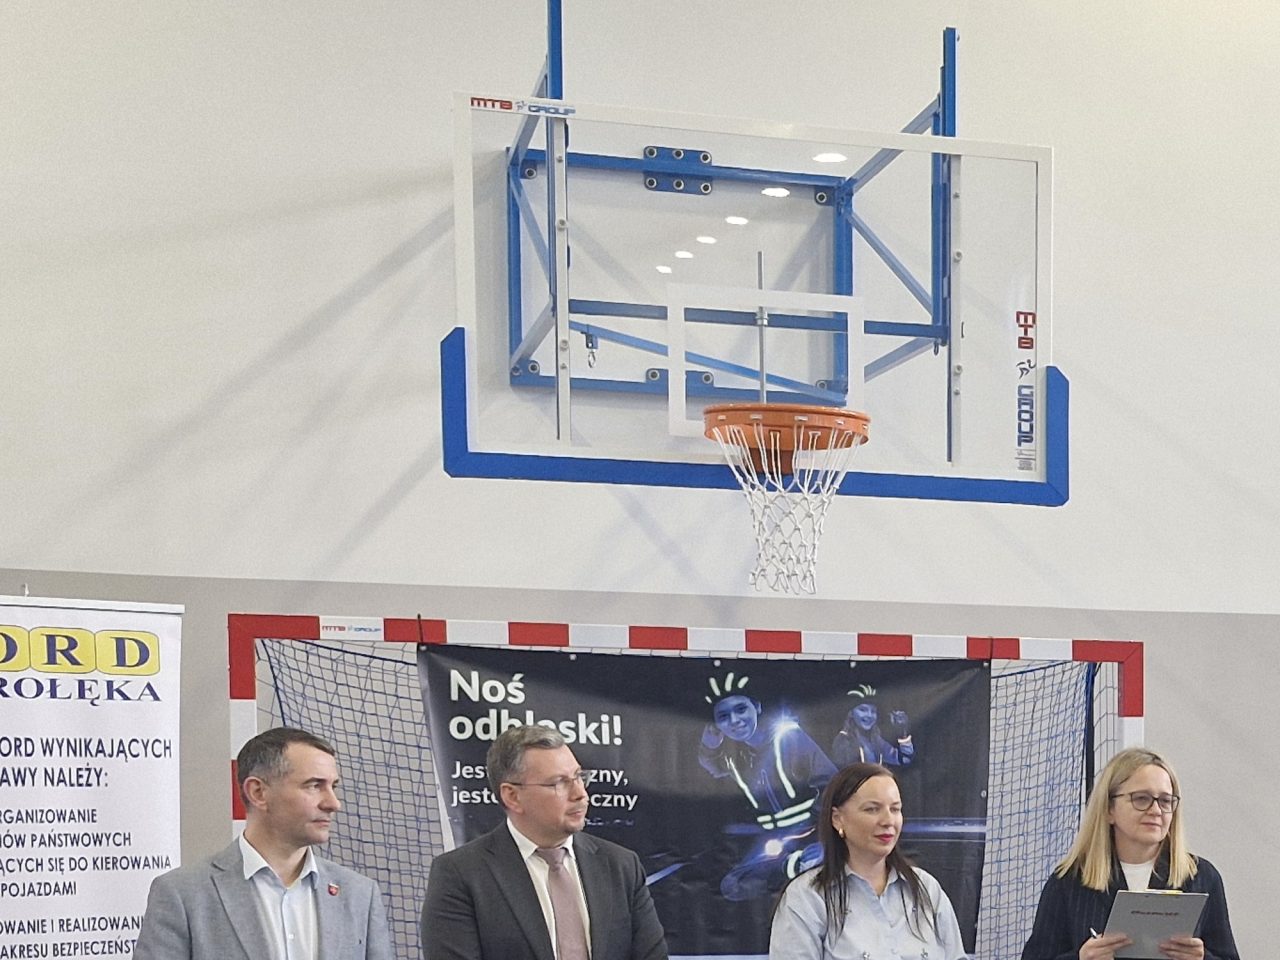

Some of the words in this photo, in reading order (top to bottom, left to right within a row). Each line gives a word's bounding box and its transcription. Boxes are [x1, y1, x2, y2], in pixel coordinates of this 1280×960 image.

[470, 97, 513, 110] MTB
[1016, 311, 1036, 349] MTB
[450, 669, 526, 704] Noś
[40, 737, 172, 763] WYNIKAJĄCYCH
[44, 762, 109, 788] NALEŻY:
[590, 793, 639, 811] czny
[0, 808, 98, 824] GANIZOWANIE
[31, 828, 132, 848] PAŃSTWOWYCH
[48, 857, 65, 875] SIĘ
[69, 856, 88, 871] DO
[92, 855, 172, 871] KIEROWANIA
[1, 881, 77, 898] POJAZDAMI
